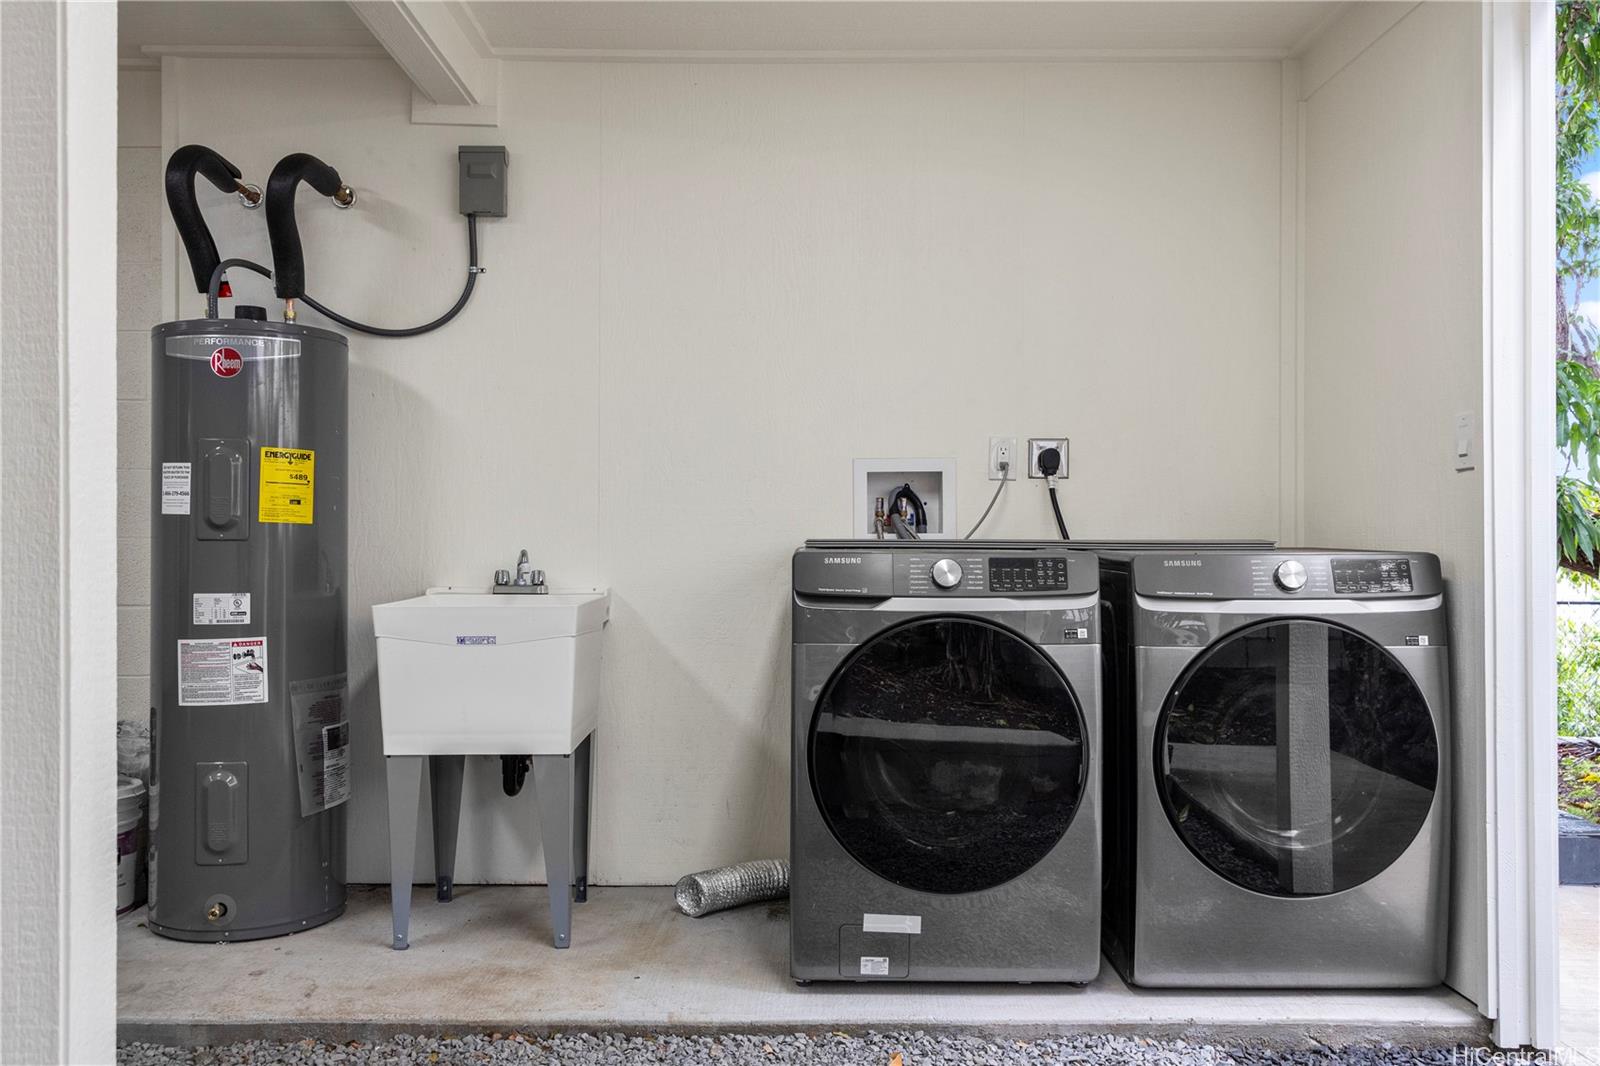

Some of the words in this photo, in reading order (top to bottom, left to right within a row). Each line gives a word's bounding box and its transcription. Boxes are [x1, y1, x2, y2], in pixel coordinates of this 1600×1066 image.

[194, 338, 264, 346] PERFORMANCE
[215, 349, 241, 373] Rheem
[265, 451, 312, 461] ENERGYGUIDE
